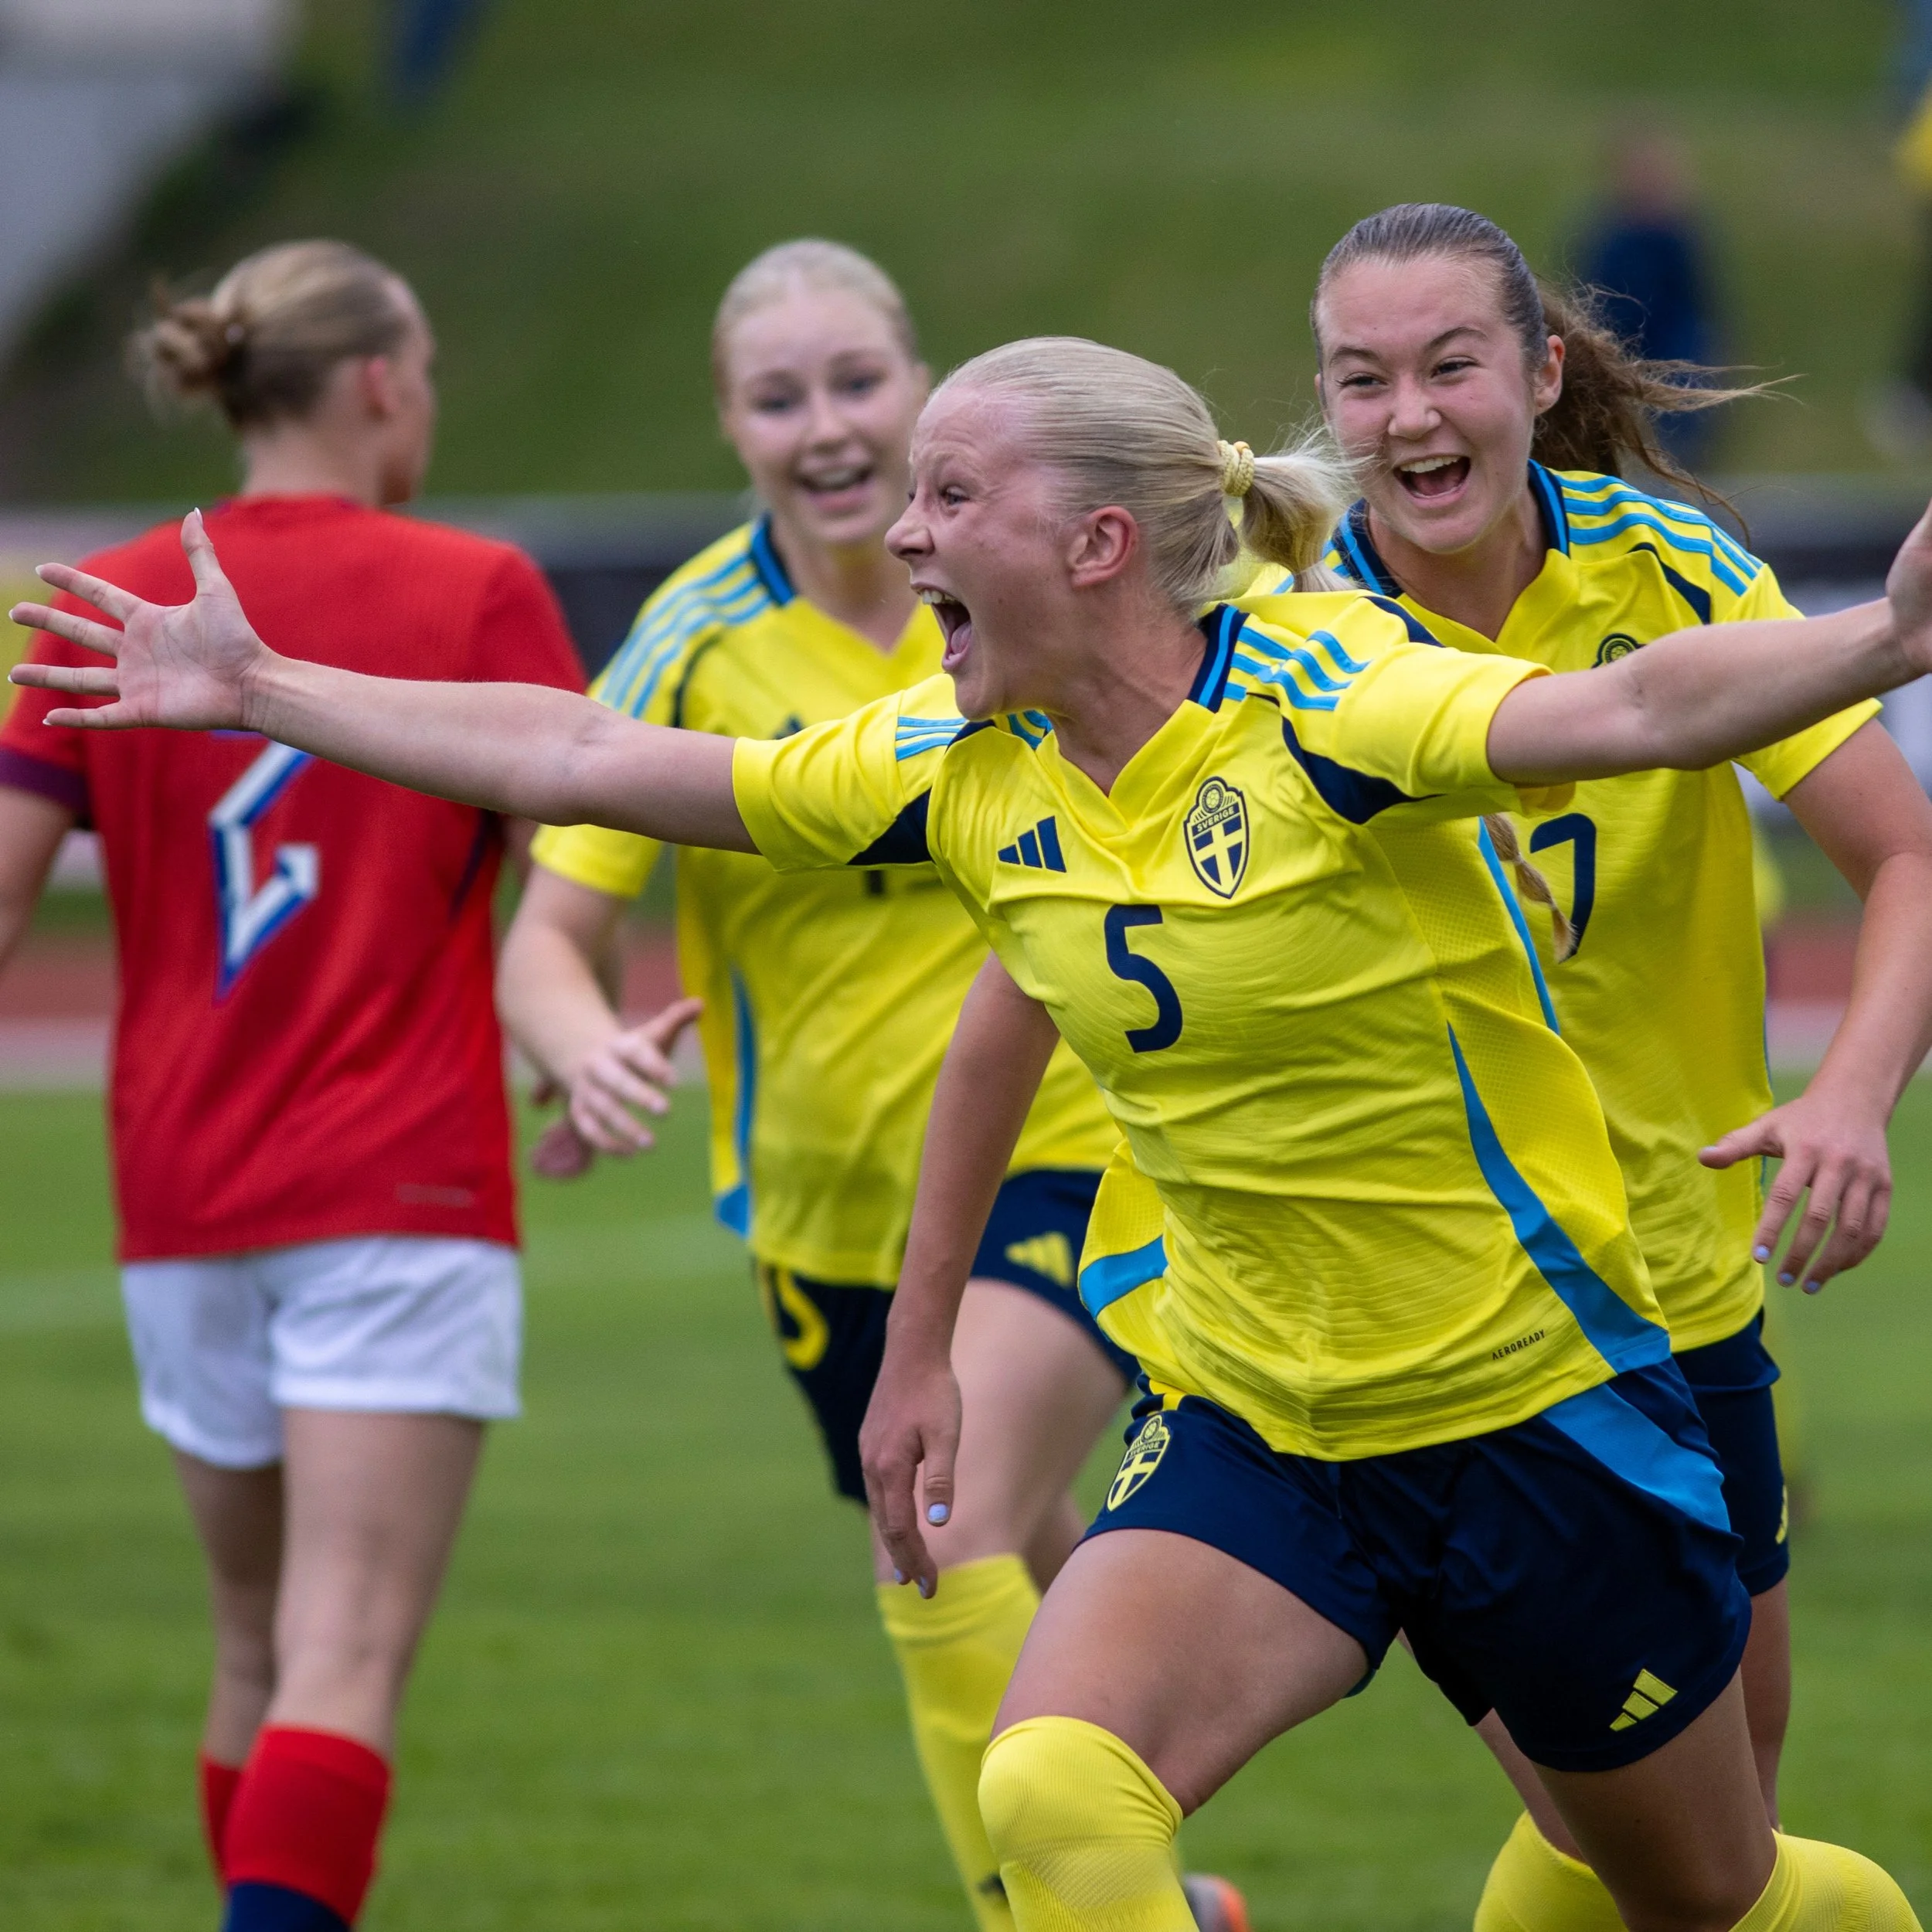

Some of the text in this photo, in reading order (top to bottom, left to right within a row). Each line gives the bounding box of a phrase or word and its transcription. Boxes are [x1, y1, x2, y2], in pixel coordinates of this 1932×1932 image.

[1197, 806, 1235, 832] SVERIGE
[1529, 812, 1597, 964] 7
[1104, 903, 1183, 1054] 5
[1492, 1329, 1546, 1360] AEROREADY
